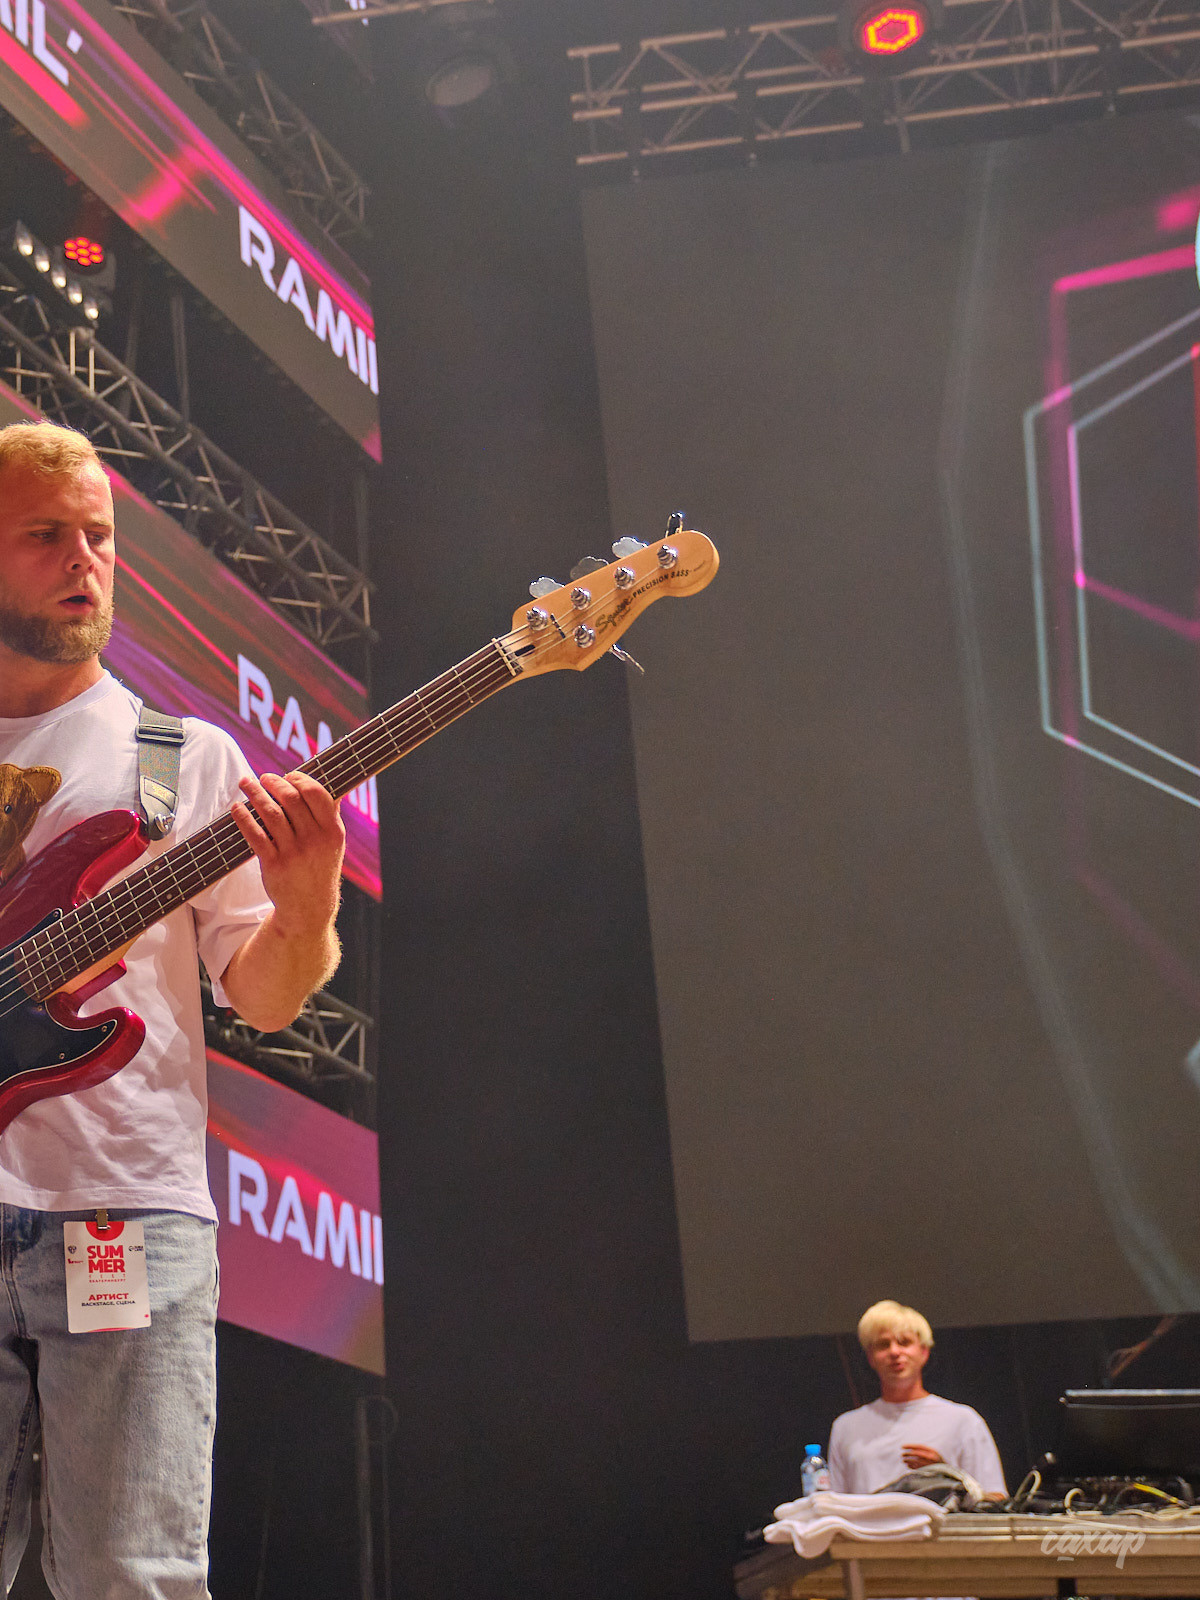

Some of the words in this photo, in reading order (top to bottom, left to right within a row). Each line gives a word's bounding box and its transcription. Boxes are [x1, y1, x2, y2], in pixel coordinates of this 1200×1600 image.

[633, 574, 669, 598] PRECISION
[670, 569, 689, 579] BASS
[86, 1245, 124, 1259] SUM
[88, 1258, 126, 1273] MER
[88, 1293, 129, 1301] АРТИСТ
